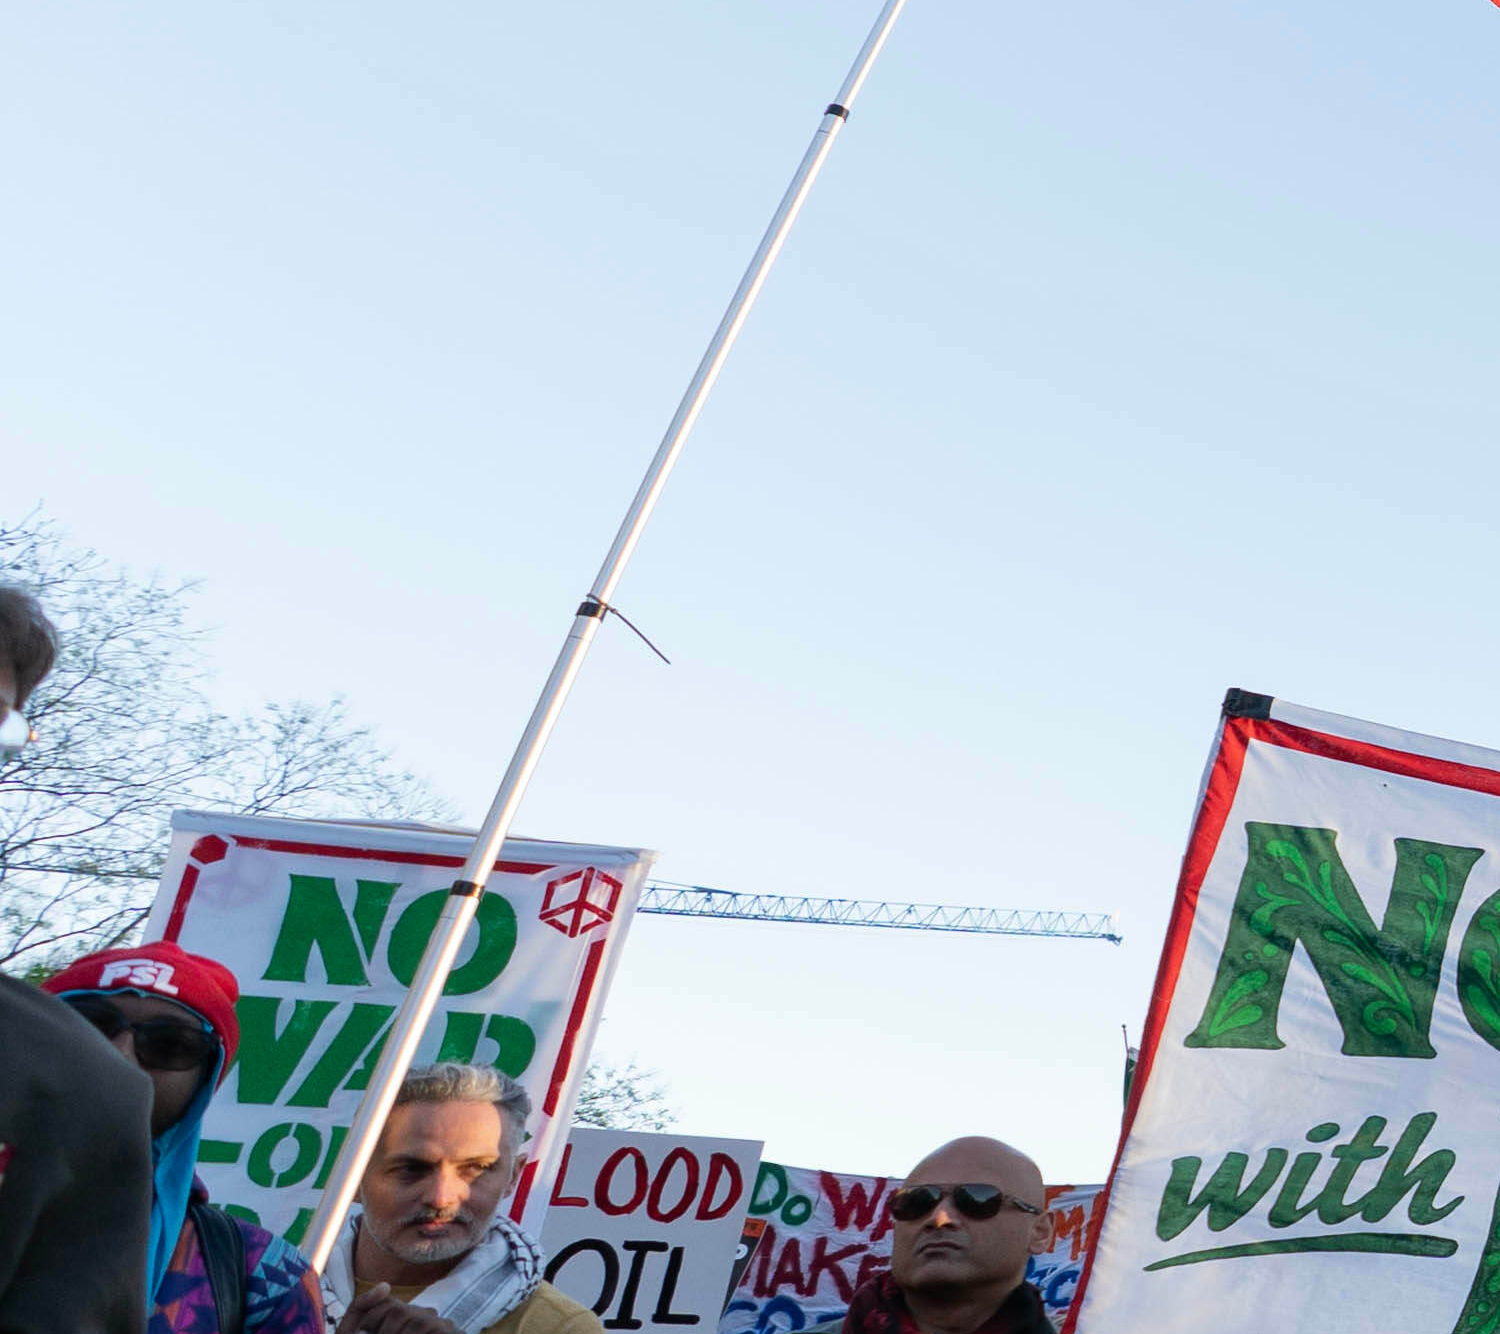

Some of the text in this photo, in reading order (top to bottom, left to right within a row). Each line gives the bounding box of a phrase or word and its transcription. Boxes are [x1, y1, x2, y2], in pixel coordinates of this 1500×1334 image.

[99, 958, 179, 995] PSL
[261, 873, 518, 997] NO
[549, 1143, 744, 1224] LOOD
[1154, 1108, 1466, 1241] with
[544, 1237, 701, 1331] OIL
